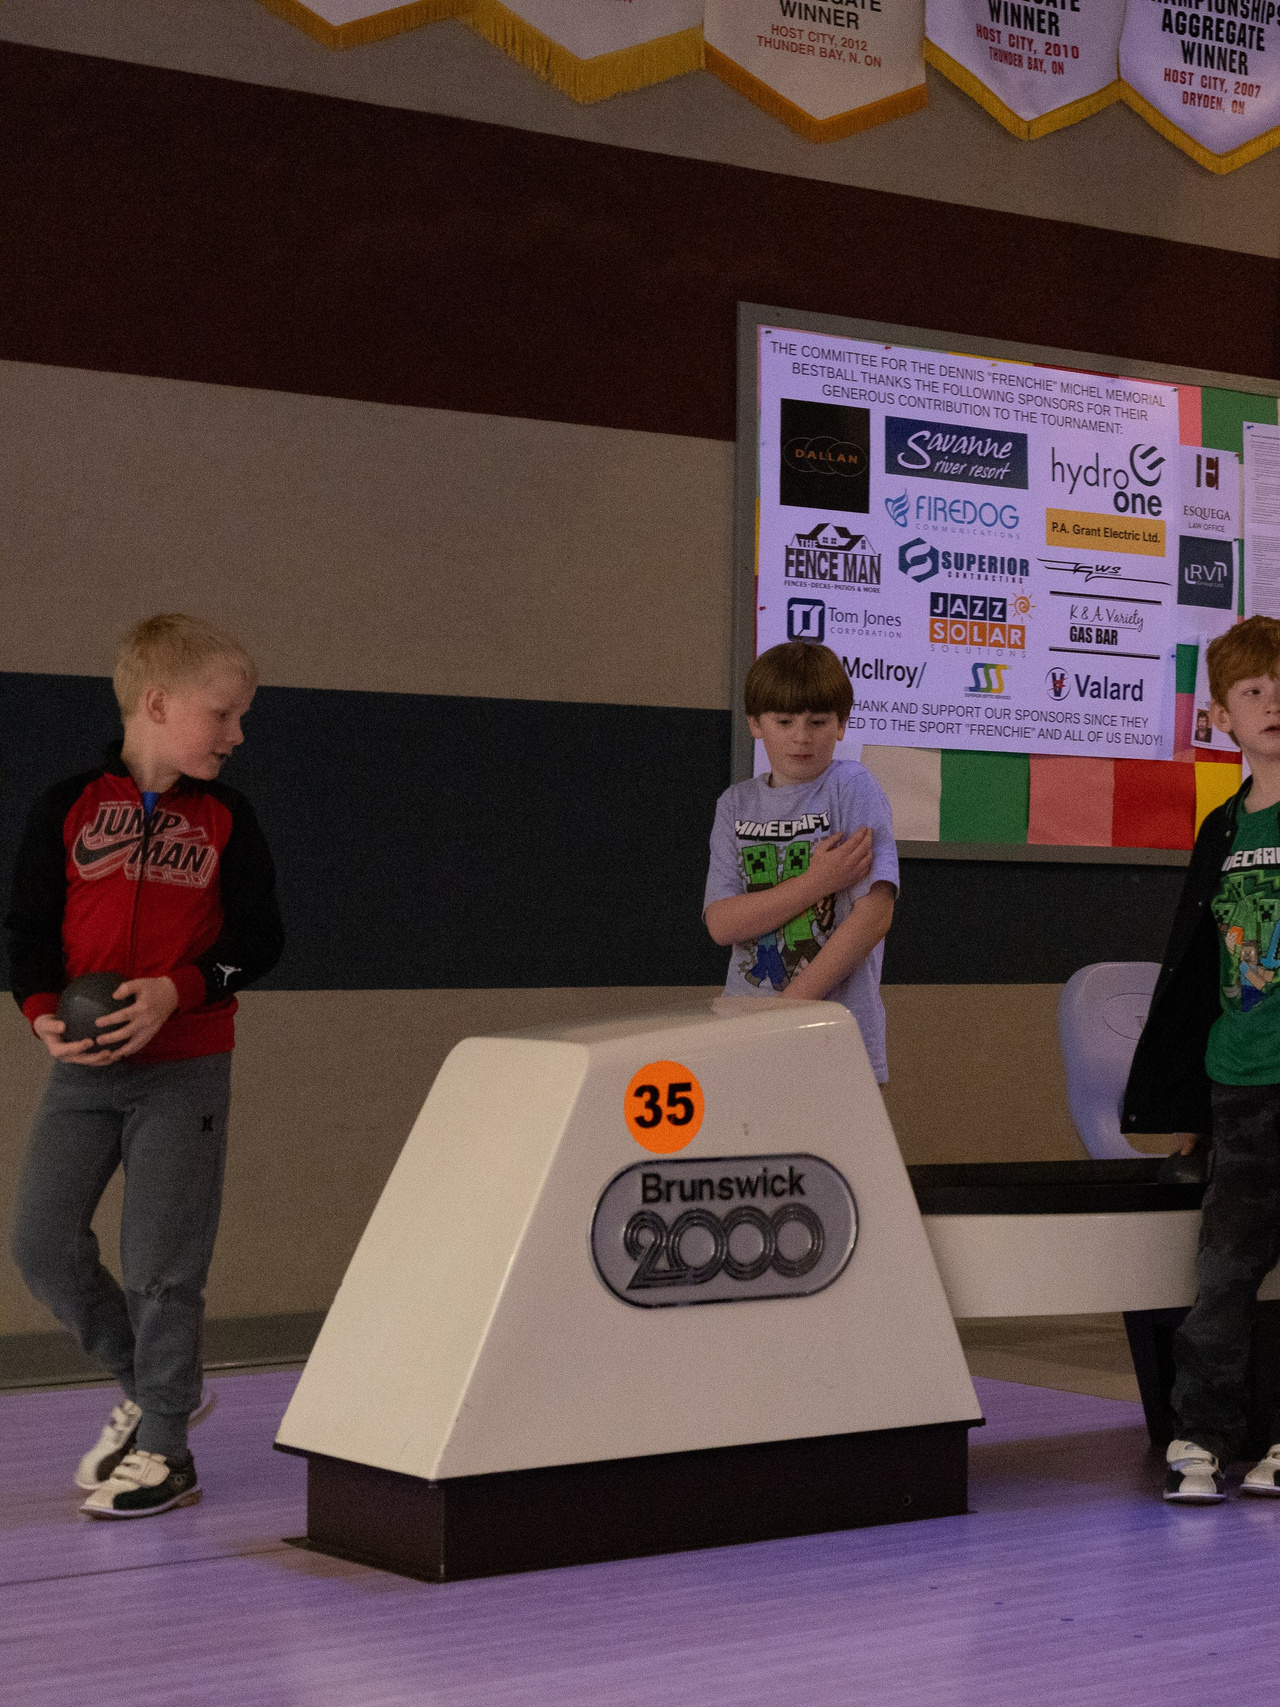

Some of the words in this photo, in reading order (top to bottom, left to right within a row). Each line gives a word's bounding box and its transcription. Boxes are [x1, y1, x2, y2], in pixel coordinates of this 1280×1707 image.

[779, 0, 859, 30] WINNER
[988, 0, 1060, 36] WINNER
[771, 24, 804, 40] HOST
[808, 30, 838, 48] CITY,
[841, 36, 868, 51] 2012
[976, 24, 1001, 44] HOST
[1009, 34, 1037, 55] CITY,
[1045, 42, 1079, 59] 2010
[1162, 9, 1265, 51] AGGREGATE
[757, 35, 815, 56] THUNDER
[820, 47, 845, 62] BAY,
[849, 52, 860, 64] N.
[865, 55, 882, 68] ON
[989, 46, 1023, 68] THUNDER
[1027, 56, 1047, 74] BAY,
[1052, 61, 1065, 75] ON
[1181, 40, 1249, 76] WINNER
[1164, 68, 1194, 86] HOST
[1201, 75, 1228, 94] CITY,
[1234, 81, 1261, 99] 2007
[1182, 91, 1225, 113] DRYDEN,
[1232, 100, 1245, 115] ON
[771, 341, 797, 356] THE
[801, 345, 877, 367] COMMITTEE
[881, 357, 907, 371] FOR
[911, 361, 935, 375] THE
[939, 365, 984, 382] DENNIS
[988, 372, 1057, 391] "FRENCHIE"
[1061, 382, 1103, 399] MICHEL
[1106, 389, 1166, 407] MEMORIAL
[792, 362, 858, 382] BESTBALL
[861, 371, 911, 389] THANKS
[914, 379, 939, 393] THE
[943, 383, 1014, 403] FOLLOWING
[1018, 394, 1084, 412] SPONSORS
[1087, 403, 1111, 416] FOR
[1114, 406, 1148, 421] THEIR
[822, 384, 894, 404] GENEROUS
[898, 395, 990, 417] CONTRIBUTION
[994, 407, 1010, 420] TO
[1014, 410, 1037, 423] THE
[1040, 413, 1123, 434] TOURNAMENT:
[795, 448, 858, 464] DALLAN
[897, 430, 1013, 469] Savanne
[934, 457, 964, 475] river
[968, 463, 1011, 480] resort
[1051, 447, 1129, 494] hydro
[916, 495, 1020, 529] FIREDOG
[1113, 491, 1162, 516] one
[1183, 505, 1231, 520] ESQUEGA
[916, 523, 1021, 540] COMMUNICATIONS
[1051, 522, 1069, 534] P.A.
[1072, 524, 1100, 537] Grant
[1103, 527, 1140, 541] Electric
[1143, 531, 1160, 543] Ltd.
[1203, 524, 1225, 532] OFFICE
[785, 548, 838, 581] FENCE
[844, 552, 881, 585] MAN
[942, 550, 1029, 577] SUPERIOR
[948, 571, 1024, 584] CONTRACTING
[1190, 563, 1222, 582] RVI
[828, 607, 858, 623] Tom
[863, 610, 901, 627] Jones
[932, 596, 1004, 619] JAZZ
[1070, 605, 1078, 620] K
[1081, 607, 1089, 619] &
[1092, 606, 1103, 621] A
[1106, 609, 1144, 632] Variety
[830, 627, 901, 638] CORPORATION
[932, 622, 1023, 646] SOLAR
[1070, 626, 1092, 643] GAS
[1095, 629, 1118, 645] BAR
[931, 644, 1027, 658] SOLUTIONS
[1074, 673, 1143, 701] Valard
[852, 700, 888, 713] HANK
[891, 702, 918, 714] AND
[922, 703, 981, 718] SUPPORT
[984, 707, 1011, 720] OUR
[1015, 709, 1080, 724] SPONSORS
[1084, 714, 1117, 726] SINCE
[1120, 716, 1149, 728] THEY
[870, 718, 887, 730] TO
[890, 719, 915, 732] THE
[919, 721, 962, 734] SPORT
[965, 723, 1035, 739] "FRENCHIE"
[1038, 728, 1062, 740] AND
[1064, 730, 1084, 742] ALL
[1087, 731, 1102, 742] OF
[1106, 732, 1121, 744] US
[1125, 733, 1163, 746] ENJOY!
[86, 806, 184, 840] JUMP
[735, 811, 830, 841] MINECRAFT
[127, 838, 210, 874] MAN
[633, 1082, 694, 1129] 35
[641, 1166, 806, 1204] Brunswick
[623, 1202, 826, 1290] 2000
